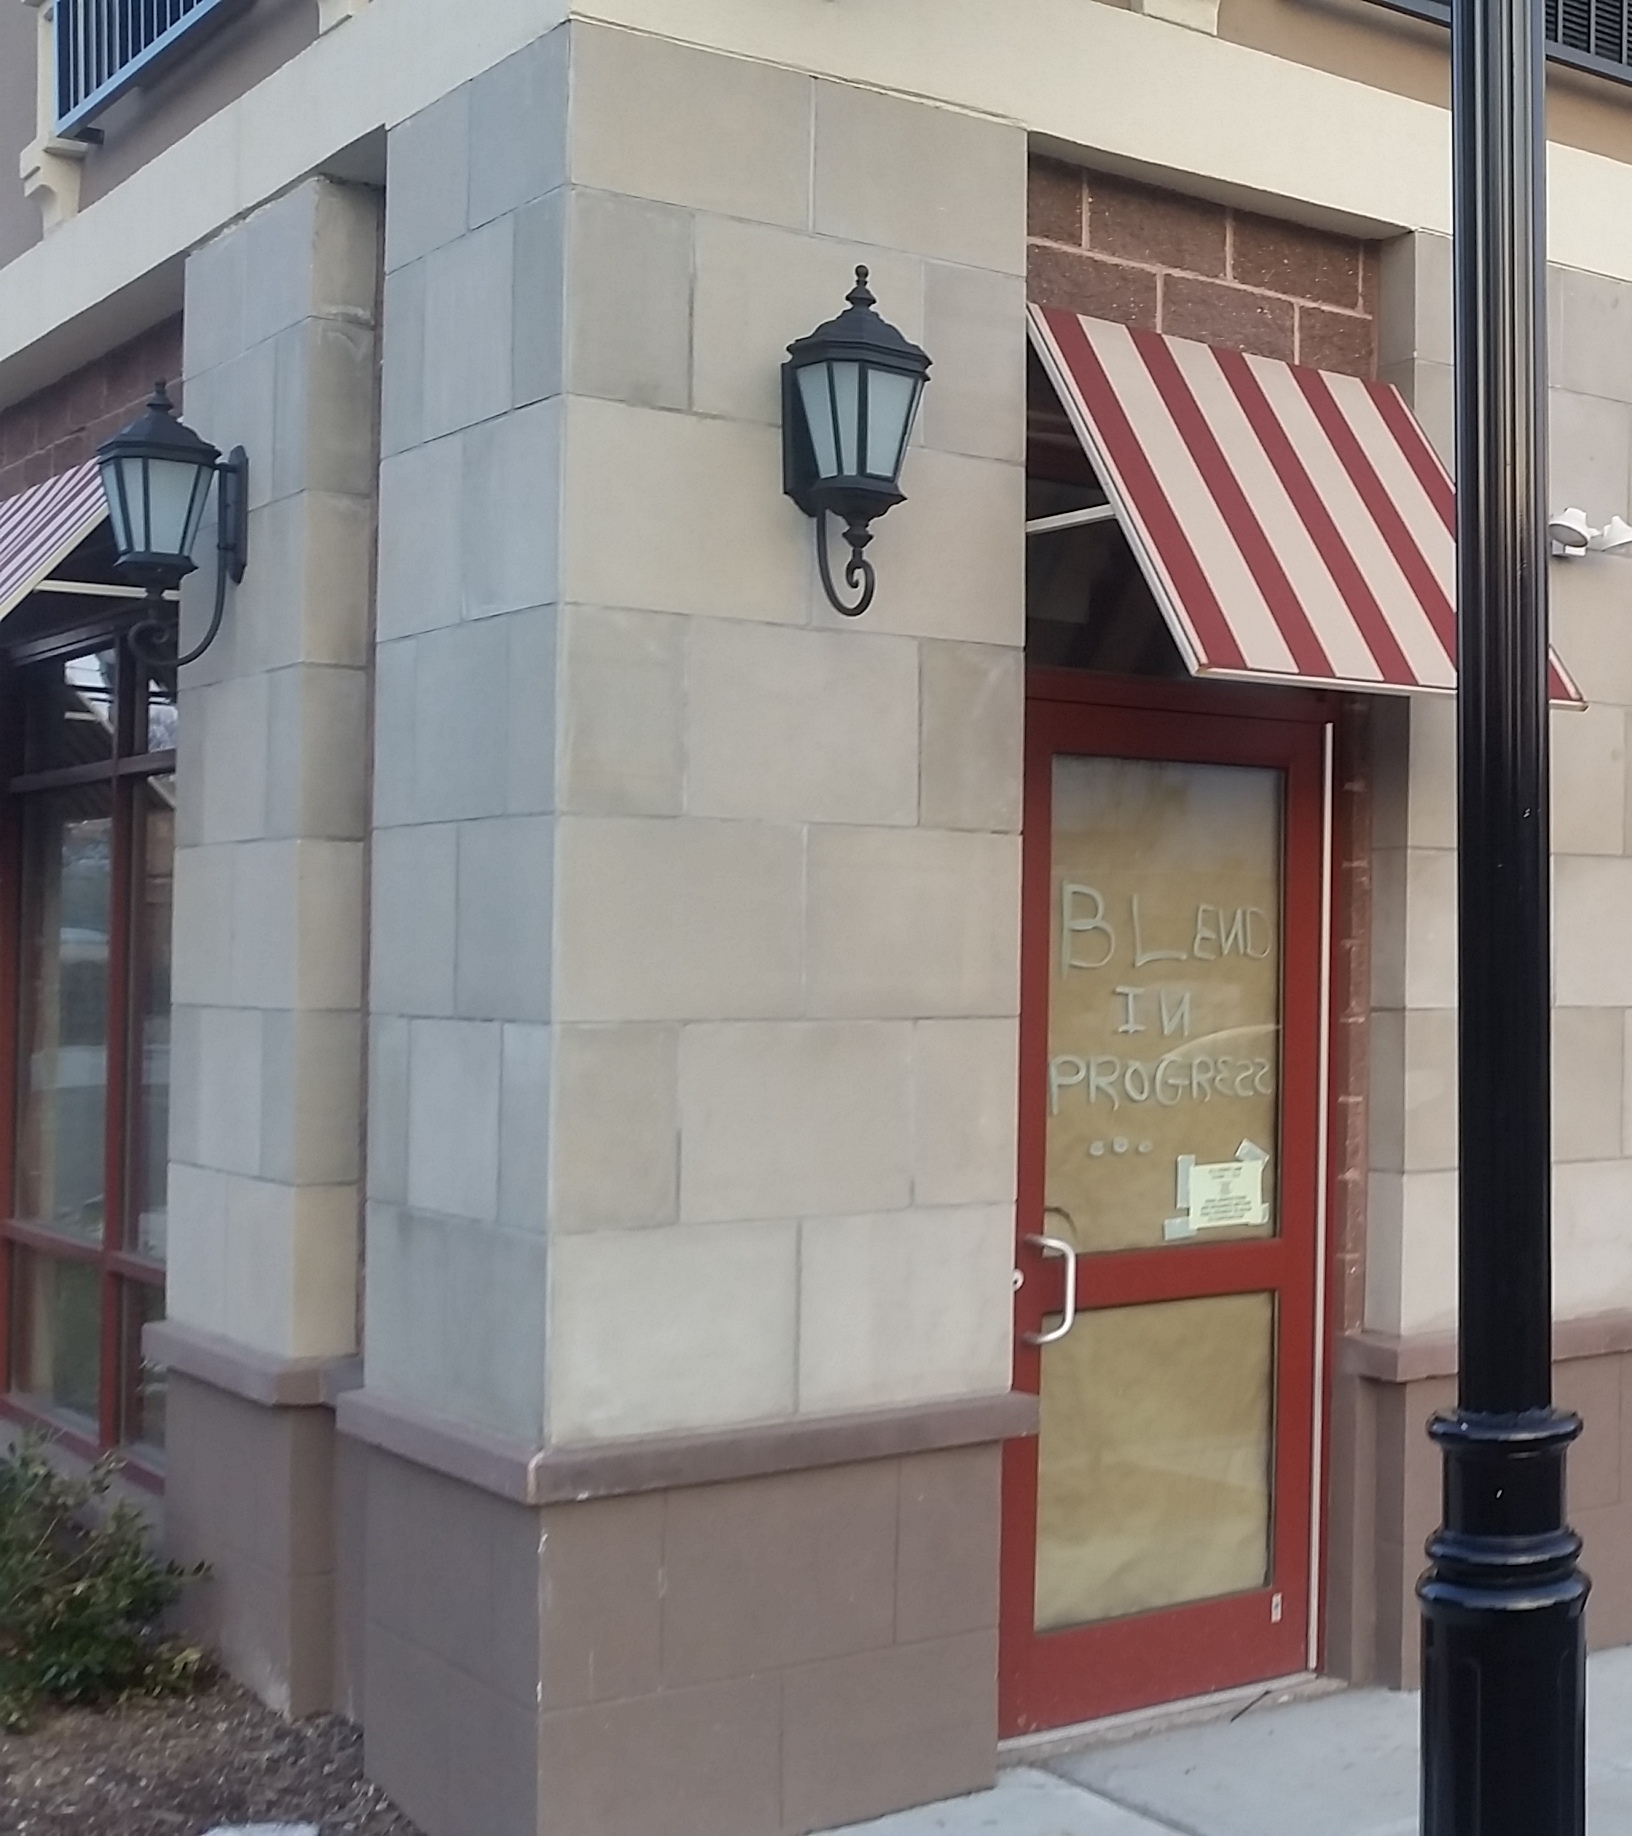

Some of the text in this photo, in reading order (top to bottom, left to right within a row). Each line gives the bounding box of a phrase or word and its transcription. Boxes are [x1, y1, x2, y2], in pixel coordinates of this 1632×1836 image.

[1061, 877, 1271, 981] BLEND
[1113, 985, 1191, 1038] IN
[1048, 1055, 1272, 1115] PROGRESS
